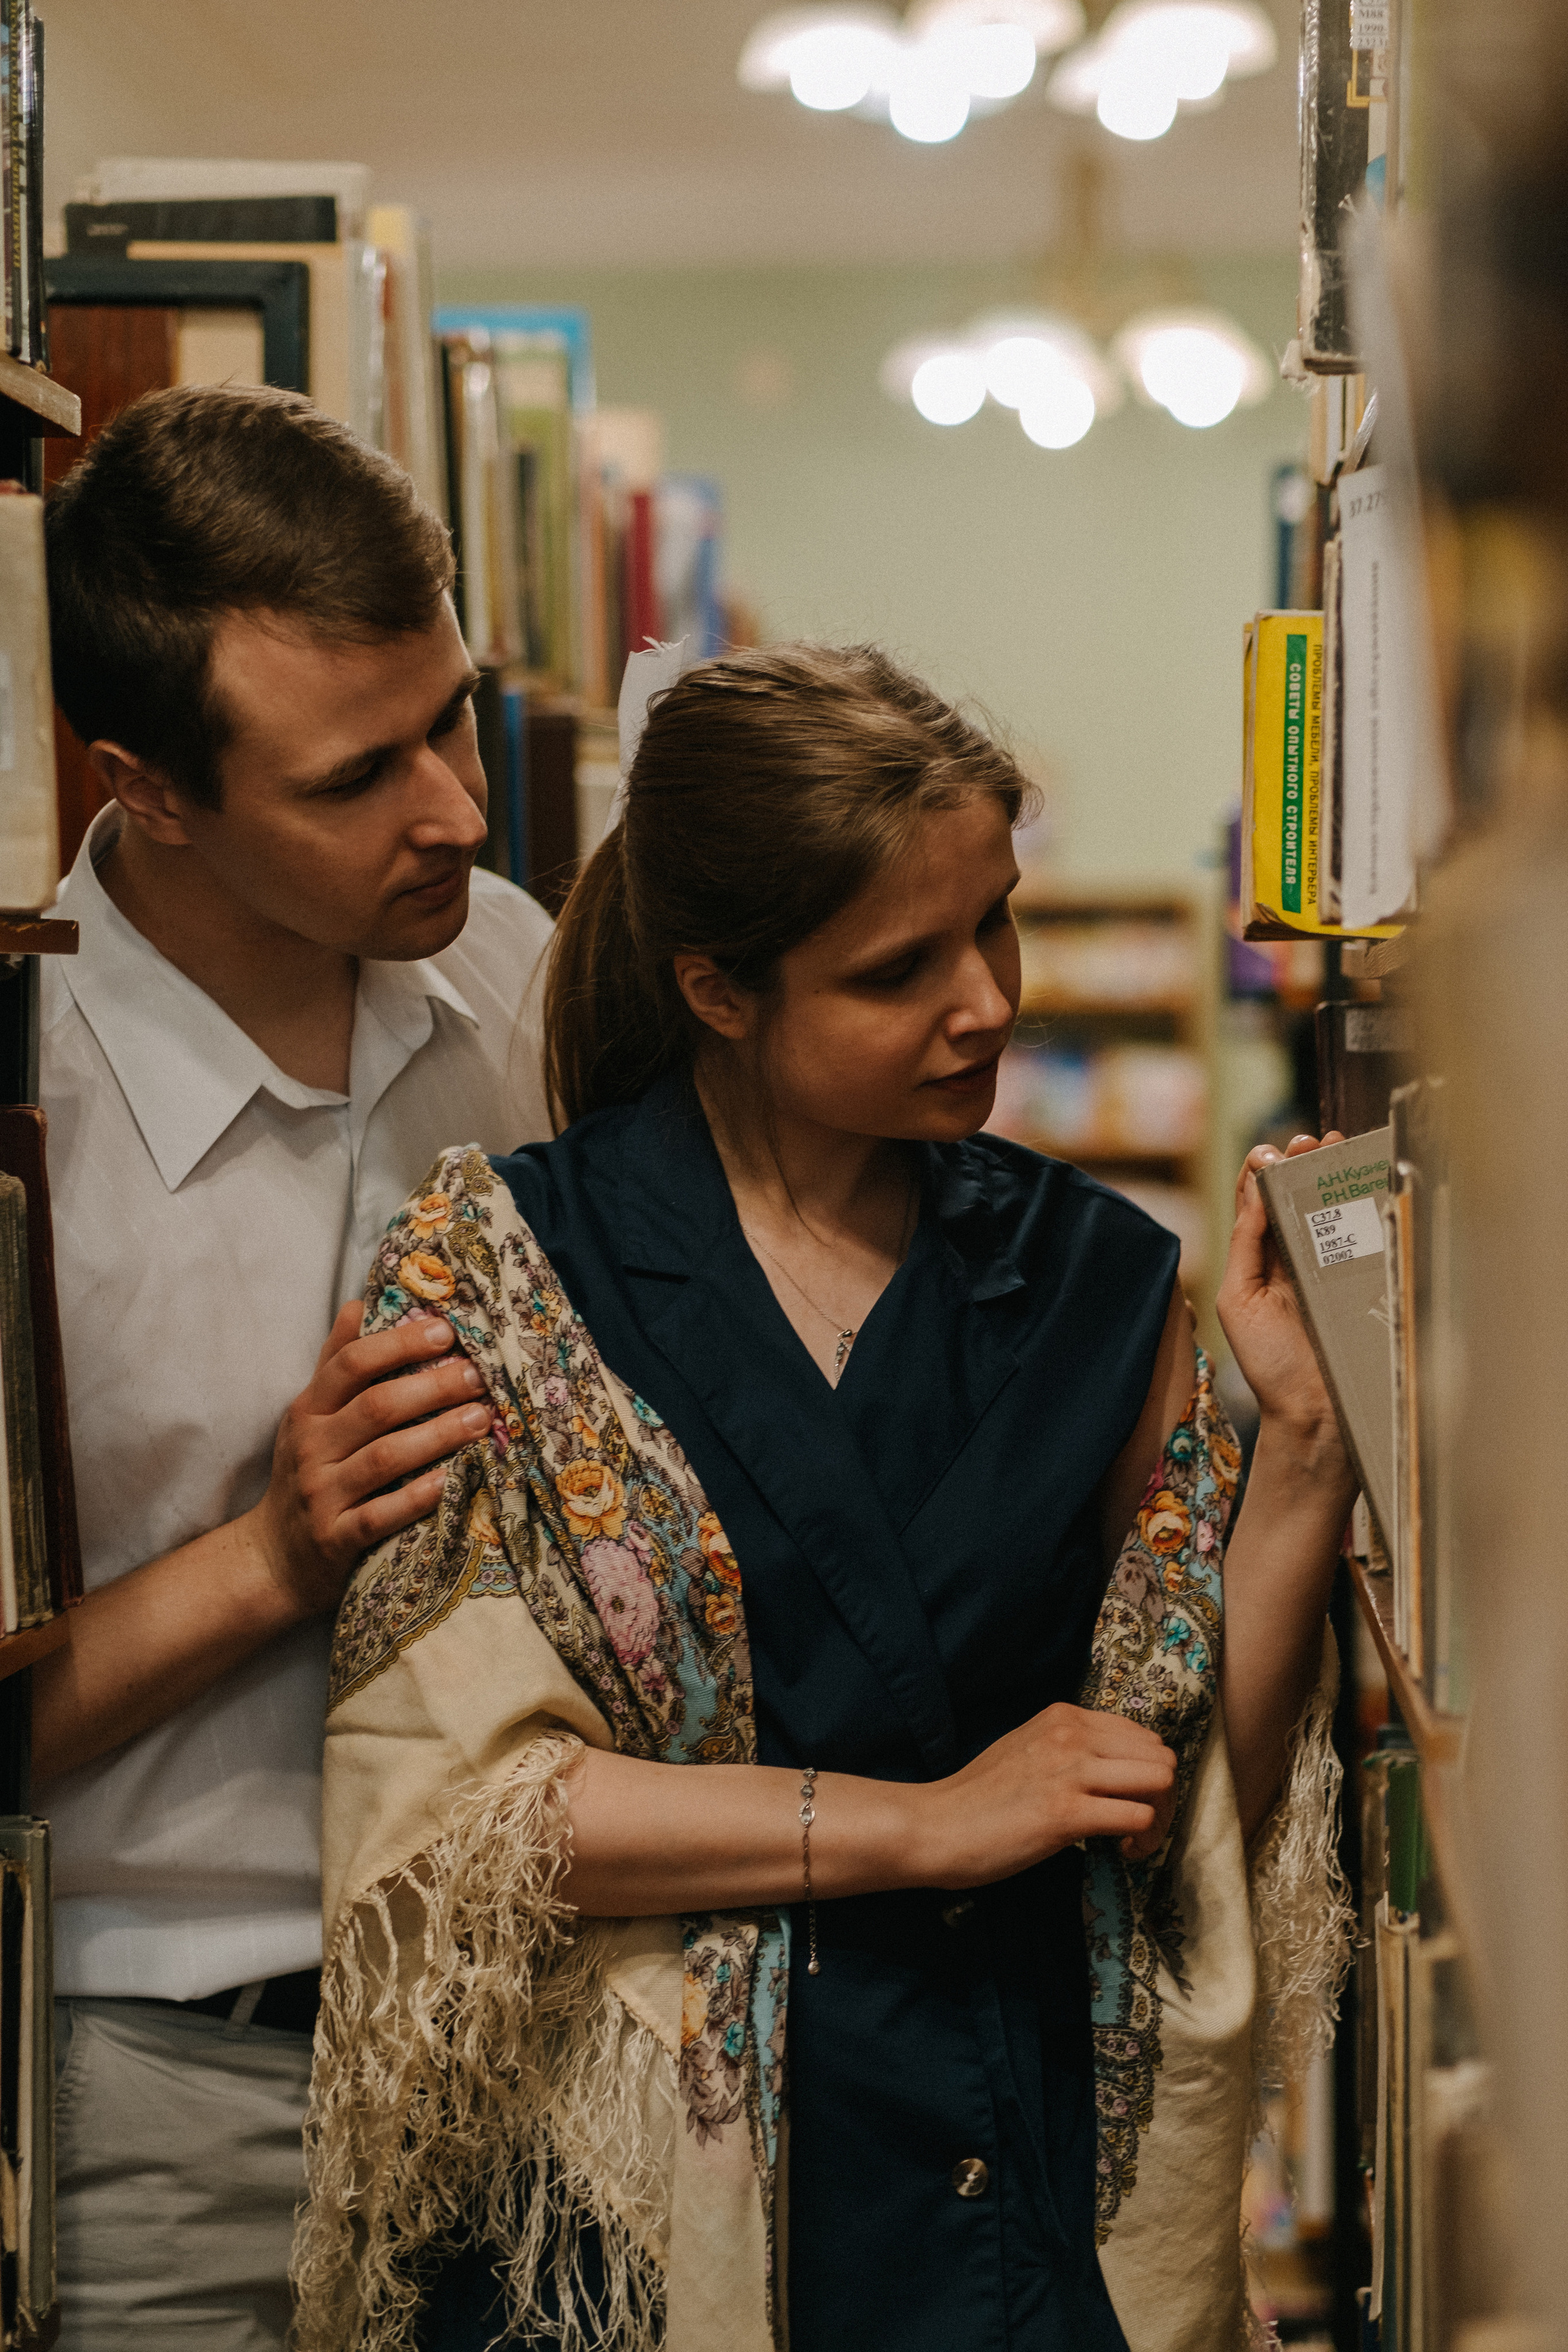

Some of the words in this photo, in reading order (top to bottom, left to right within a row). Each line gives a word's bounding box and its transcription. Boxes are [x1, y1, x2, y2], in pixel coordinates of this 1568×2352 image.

[1288, 663, 1302, 719] СОВЕТЫ
[1311, 644, 1322, 710] ПРОБЛЕМЫ
[1286, 725, 1300, 799] ОПЫТНОГО
[1310, 715, 1320, 765] МЕБЕЛИ,
[1308, 771, 1319, 835] ПРОБЛЕМЫ
[1285, 805, 1298, 884] СТРОИТЕЛЯ
[1308, 840, 1317, 905] ИНТЕРЬЕРА
